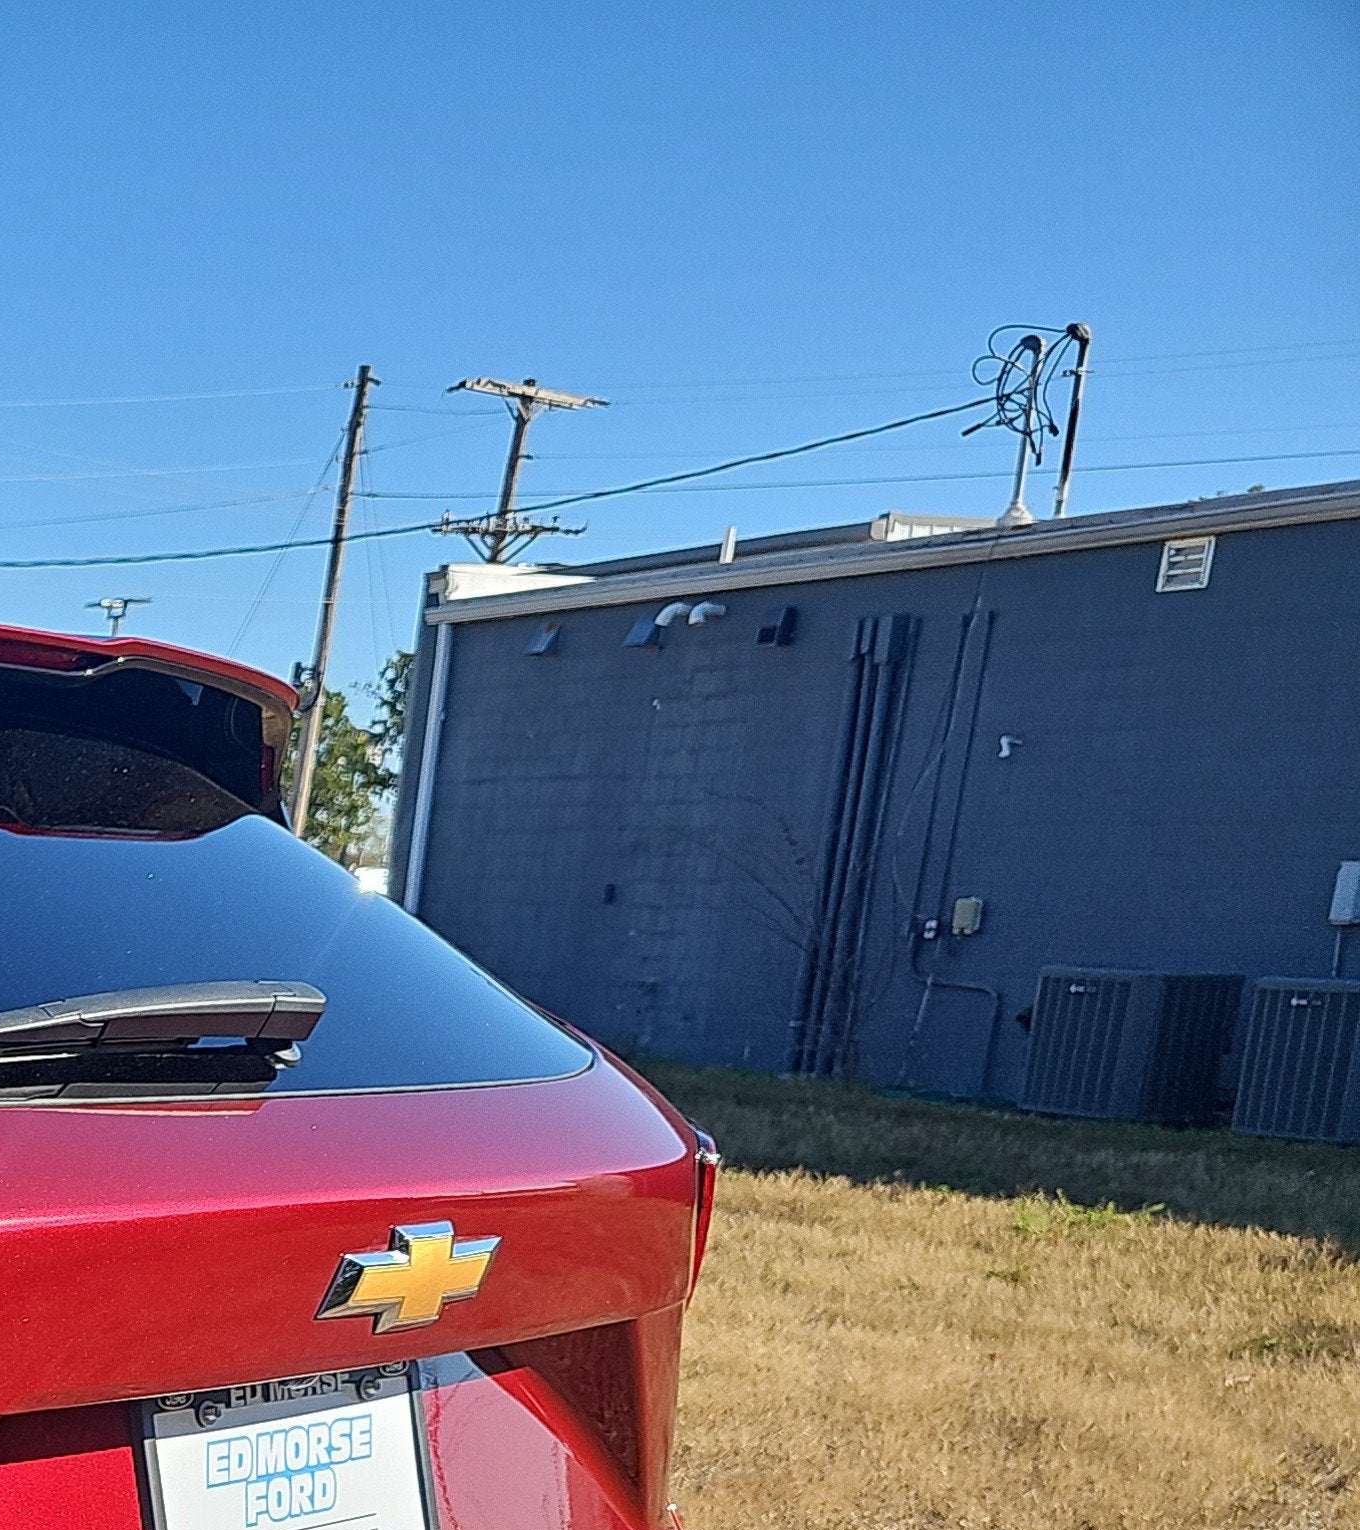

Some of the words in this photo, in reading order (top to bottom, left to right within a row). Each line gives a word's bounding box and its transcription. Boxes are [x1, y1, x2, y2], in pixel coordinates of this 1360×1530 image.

[206, 1436, 254, 1489] ED
[255, 1414, 372, 1480] MORSE
[246, 1467, 337, 1528] FORD
